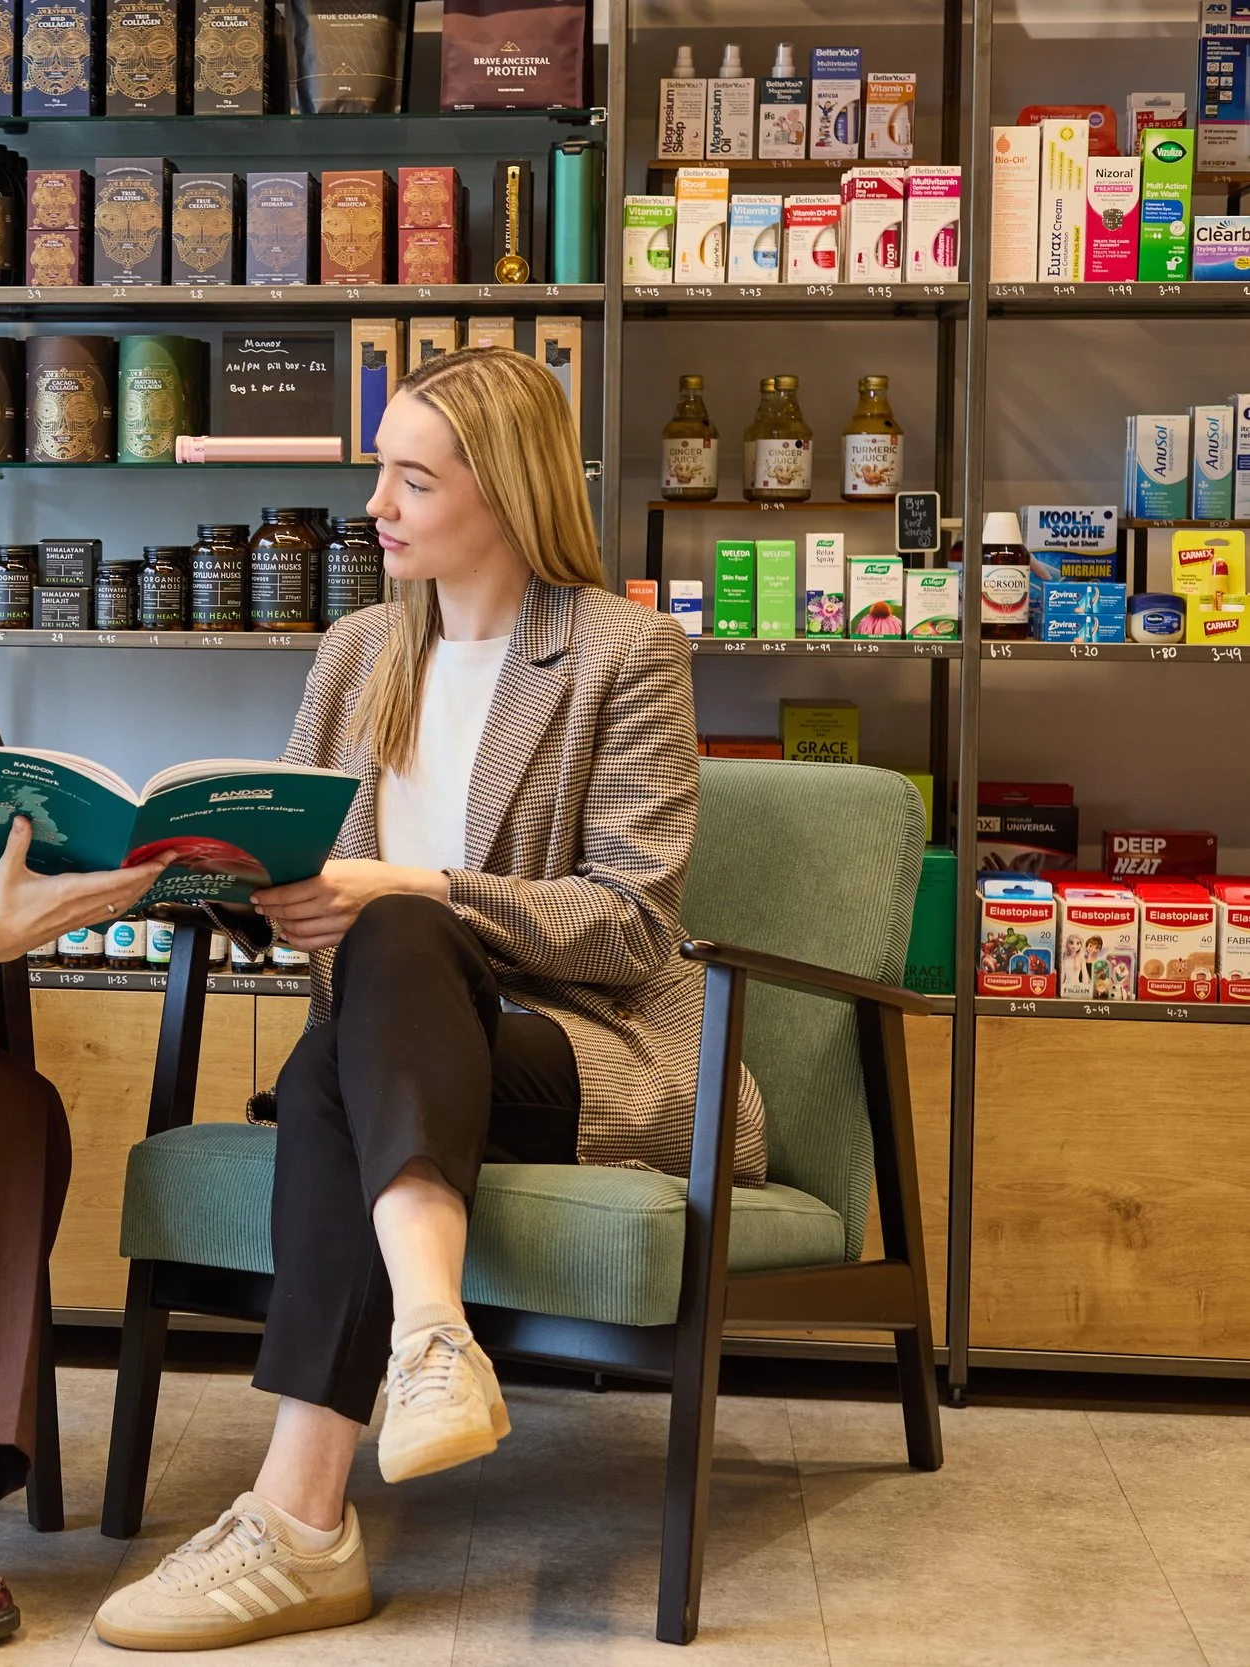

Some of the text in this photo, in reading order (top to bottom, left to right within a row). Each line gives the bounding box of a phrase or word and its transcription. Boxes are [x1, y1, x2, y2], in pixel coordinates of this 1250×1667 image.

[1206, 24, 1228, 34] Digital
[474, 57, 550, 65] BRAVE ANCESTRAL
[486, 66, 537, 76] PROTEIN
[870, 84, 912, 93] Vitamin D
[662, 89, 674, 153] Magnesium
[710, 89, 721, 153] Magnesium
[673, 122, 685, 153] Sleep
[721, 138, 732, 153] Oil
[1157, 148, 1182, 157] Vizulize
[1096, 169, 1133, 178] Nizoral
[856, 179, 877, 189] Iron
[912, 178, 958, 186] Multivitamin
[1159, 190, 1179, 198] Wash
[629, 207, 663, 216] Vitamin
[734, 207, 769, 215] Vitamin
[1048, 199, 1062, 276] Eurax Cream
[885, 243, 894, 268] Iron
[28, 289, 41, 299] 39
[113, 288, 127, 297] 22
[190, 290, 203, 299] 28
[245, 339, 281, 348] Mannox
[310, 361, 326, 371] £32
[670, 448, 702, 456] GINGER
[852, 446, 897, 454] TURMERIC
[860, 454, 887, 462] JUICE
[1051, 525, 1105, 538] SOOTHE
[251, 553, 302, 561] ORGANIC
[328, 555, 378, 563] ORGANIC
[1181, 549, 1213, 560] CARMEX
[193, 561, 242, 570] ORGANIC
[279, 563, 302, 571] HUSKS
[328, 564, 378, 572] SPIRULINA
[1061, 565, 1111, 576] MIGRAINE
[1049, 591, 1077, 600] Zovirax
[1049, 620, 1077, 630] Zovirax
[1206, 620, 1237, 630] CARMEX
[52, 633, 64, 642] 29
[1151, 647, 1177, 659] 1-80
[1212, 648, 1242, 661] 3-49
[797, 741, 848, 754] GRACE
[13, 762, 54, 775] RANDOX
[22, 772, 59, 786] Network
[210, 789, 274, 799] RANDOX
[170, 808, 214, 822] Pathology
[1007, 824, 1056, 832] UNIVERSAL
[1113, 837, 1167, 854] DEEP
[1114, 858, 1161, 875] HEAT
[990, 907, 1049, 918] Elastoplast
[1071, 910, 1130, 922] Elastoplast
[1150, 910, 1209, 922] Elastoplast
[1040, 931, 1051, 939] 20
[1119, 935, 1130, 943] 20
[1145, 934, 1179, 943] FABRIC
[1201, 935, 1213, 943] 40
[987, 978, 1019, 986] Elastoplast
[1150, 983, 1183, 991] Elastoplast
